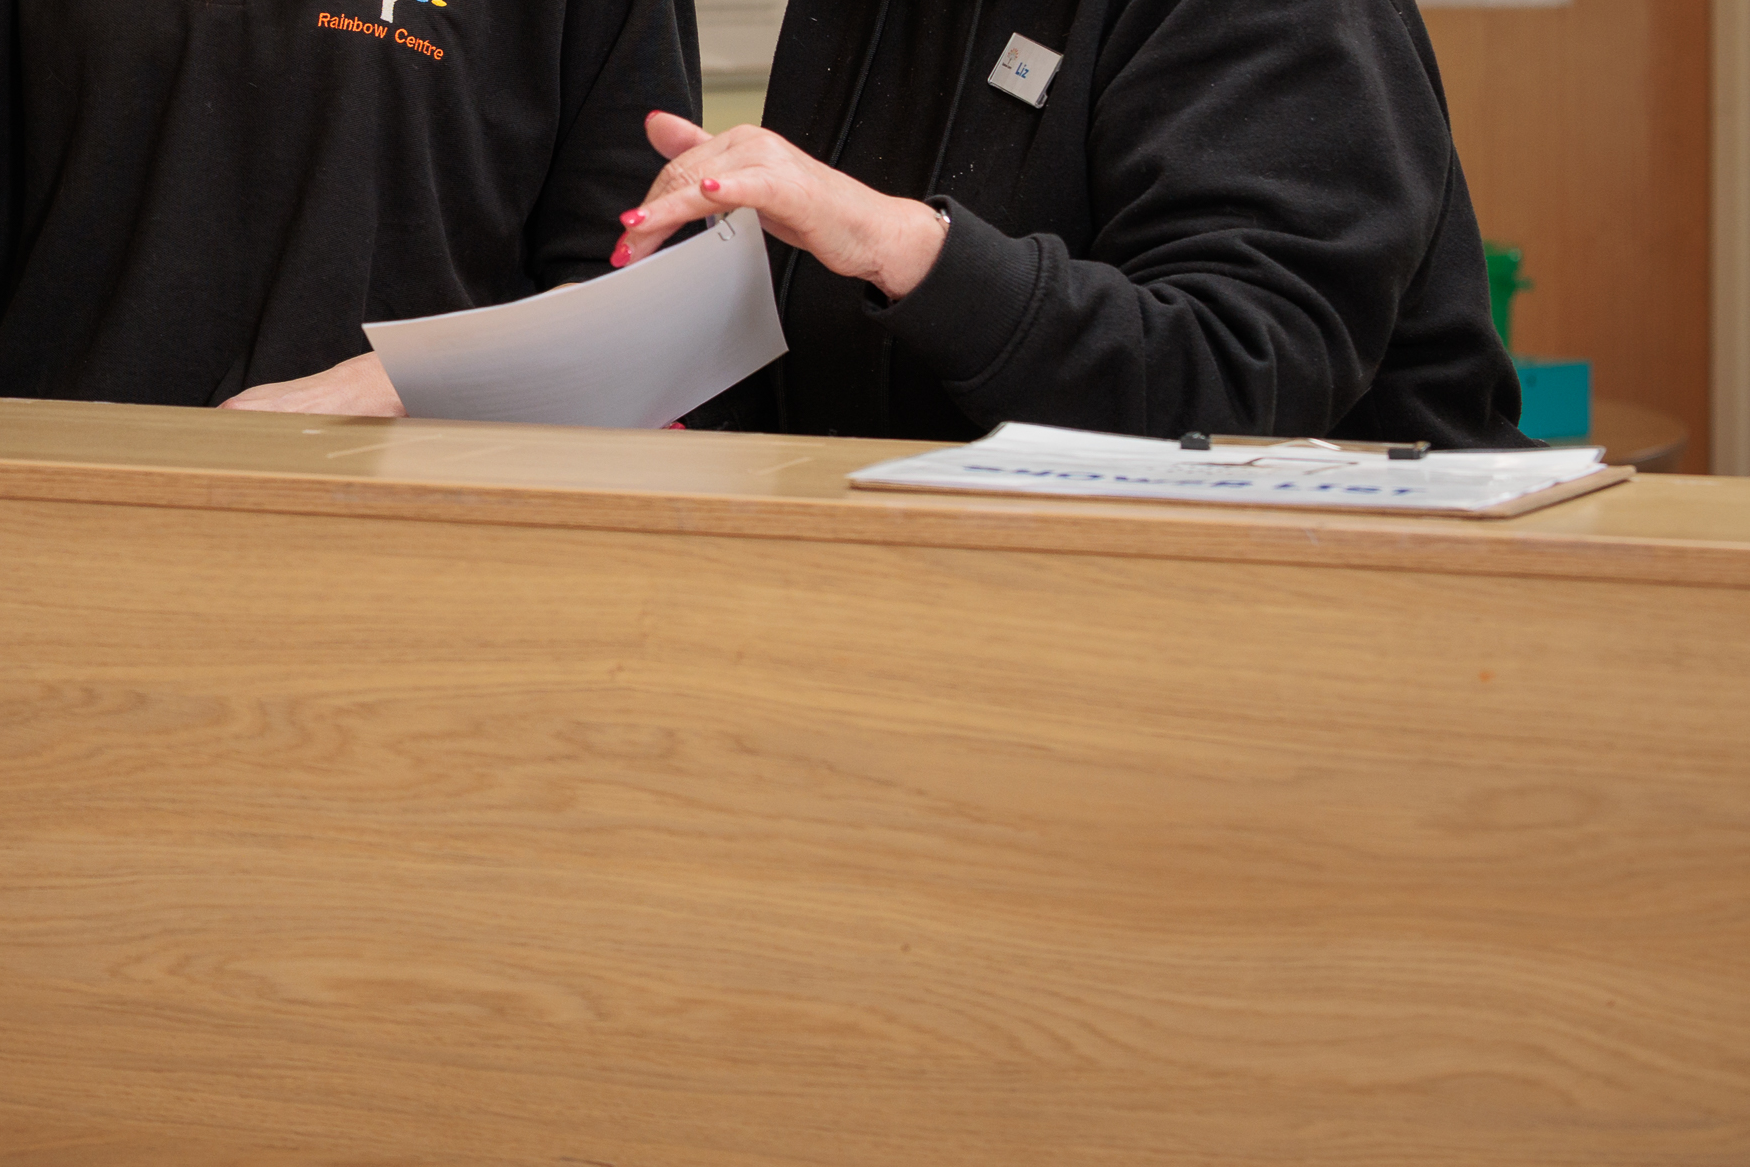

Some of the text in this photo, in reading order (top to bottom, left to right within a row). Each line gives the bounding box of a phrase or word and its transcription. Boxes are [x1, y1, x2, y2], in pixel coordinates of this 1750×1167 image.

[317, 12, 444, 60] Rainbow Centre
[1015, 62, 1030, 79] Liz
